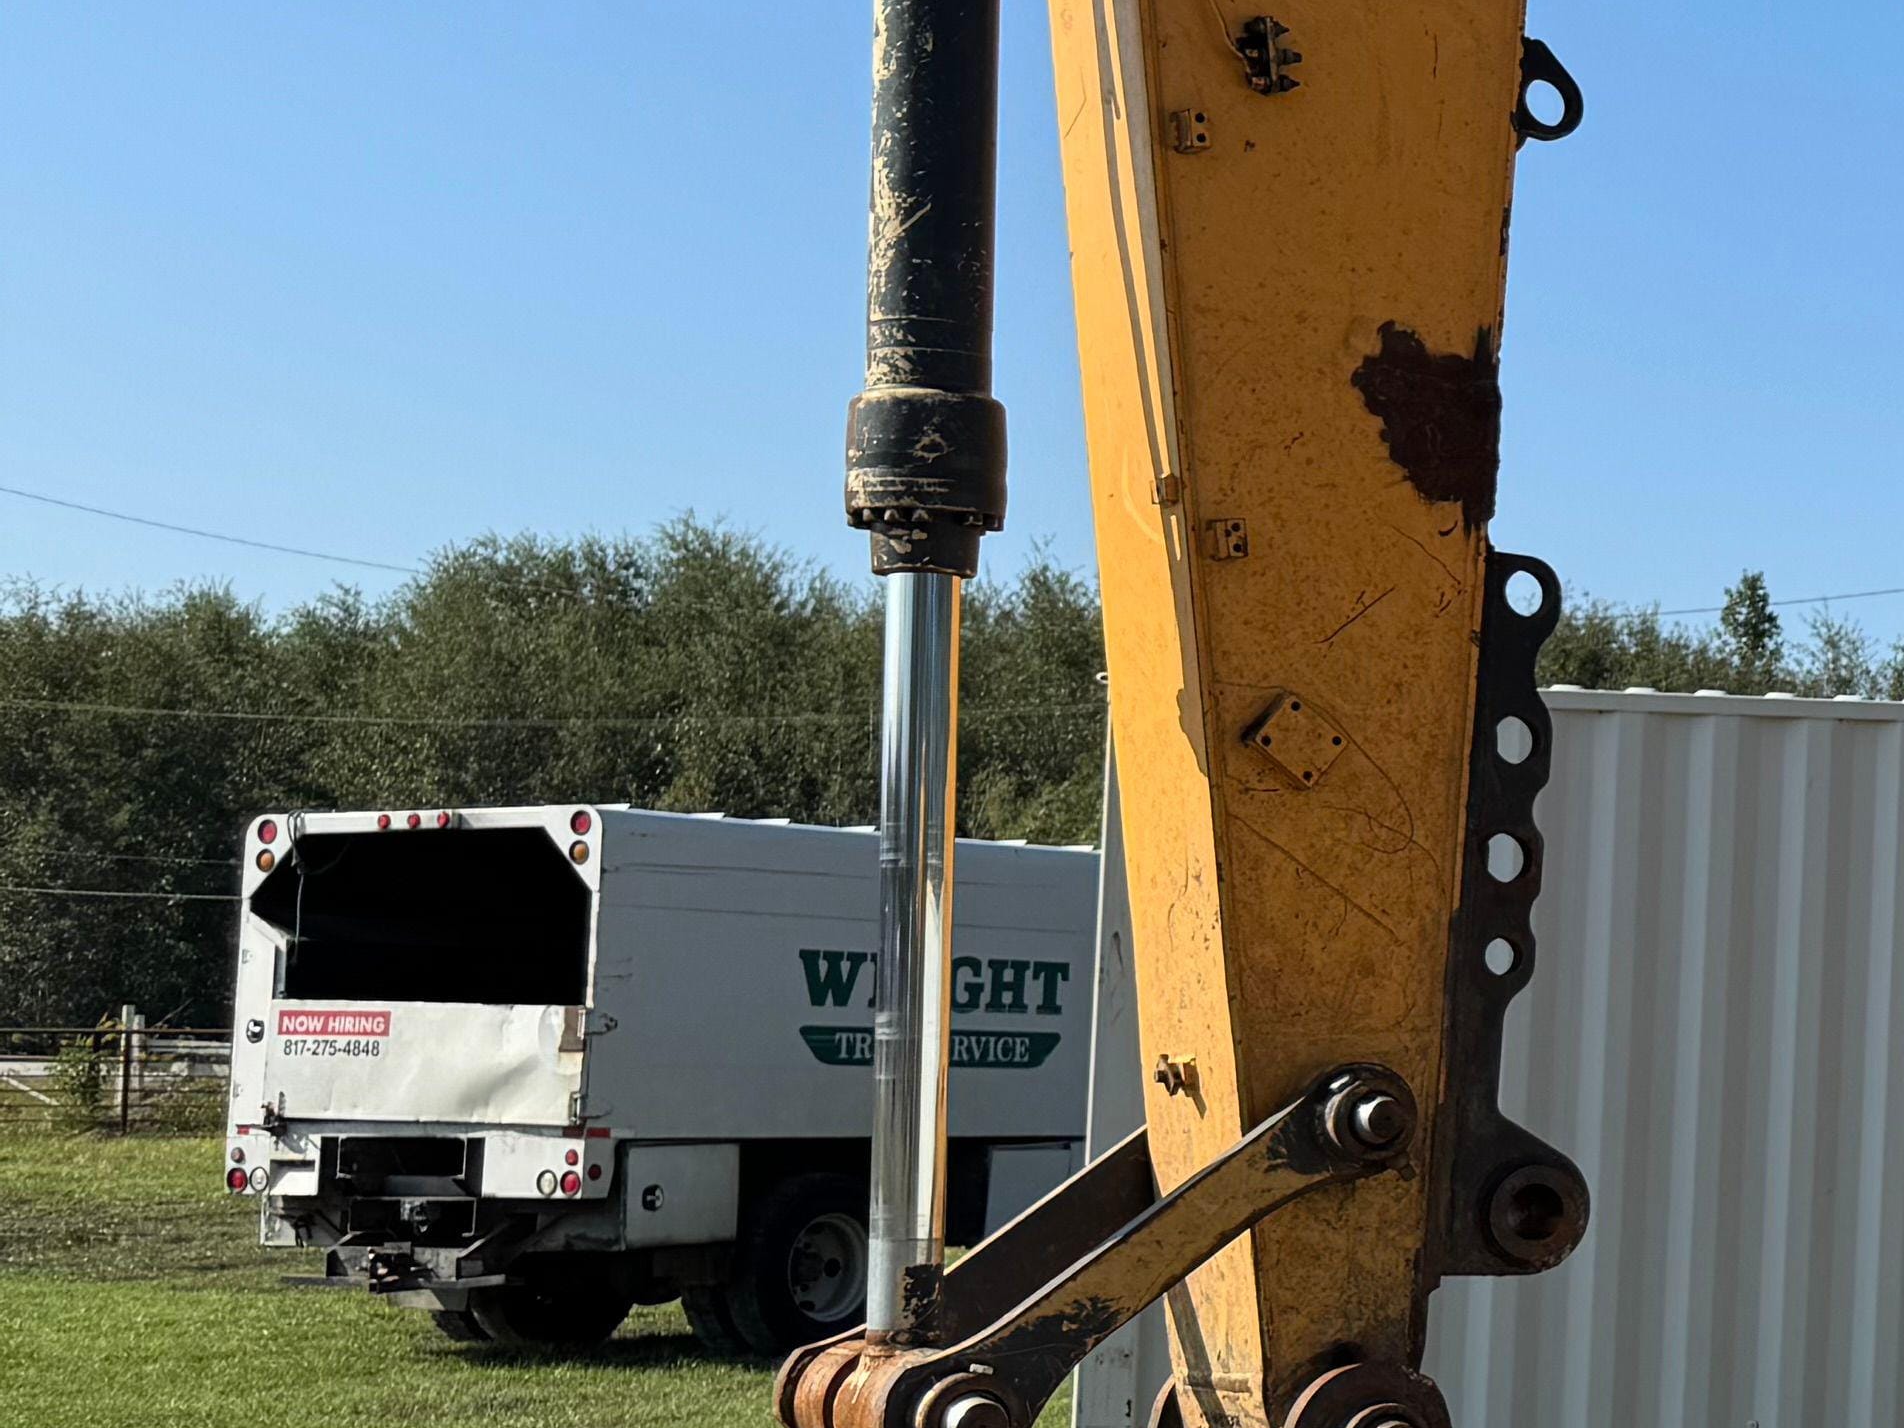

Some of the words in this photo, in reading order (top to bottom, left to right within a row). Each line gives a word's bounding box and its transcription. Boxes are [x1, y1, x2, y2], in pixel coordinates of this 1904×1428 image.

[281, 1015, 325, 1033] NOW
[327, 1016, 385, 1034] HIRING
[283, 1039, 380, 1057] 817-275-4848
